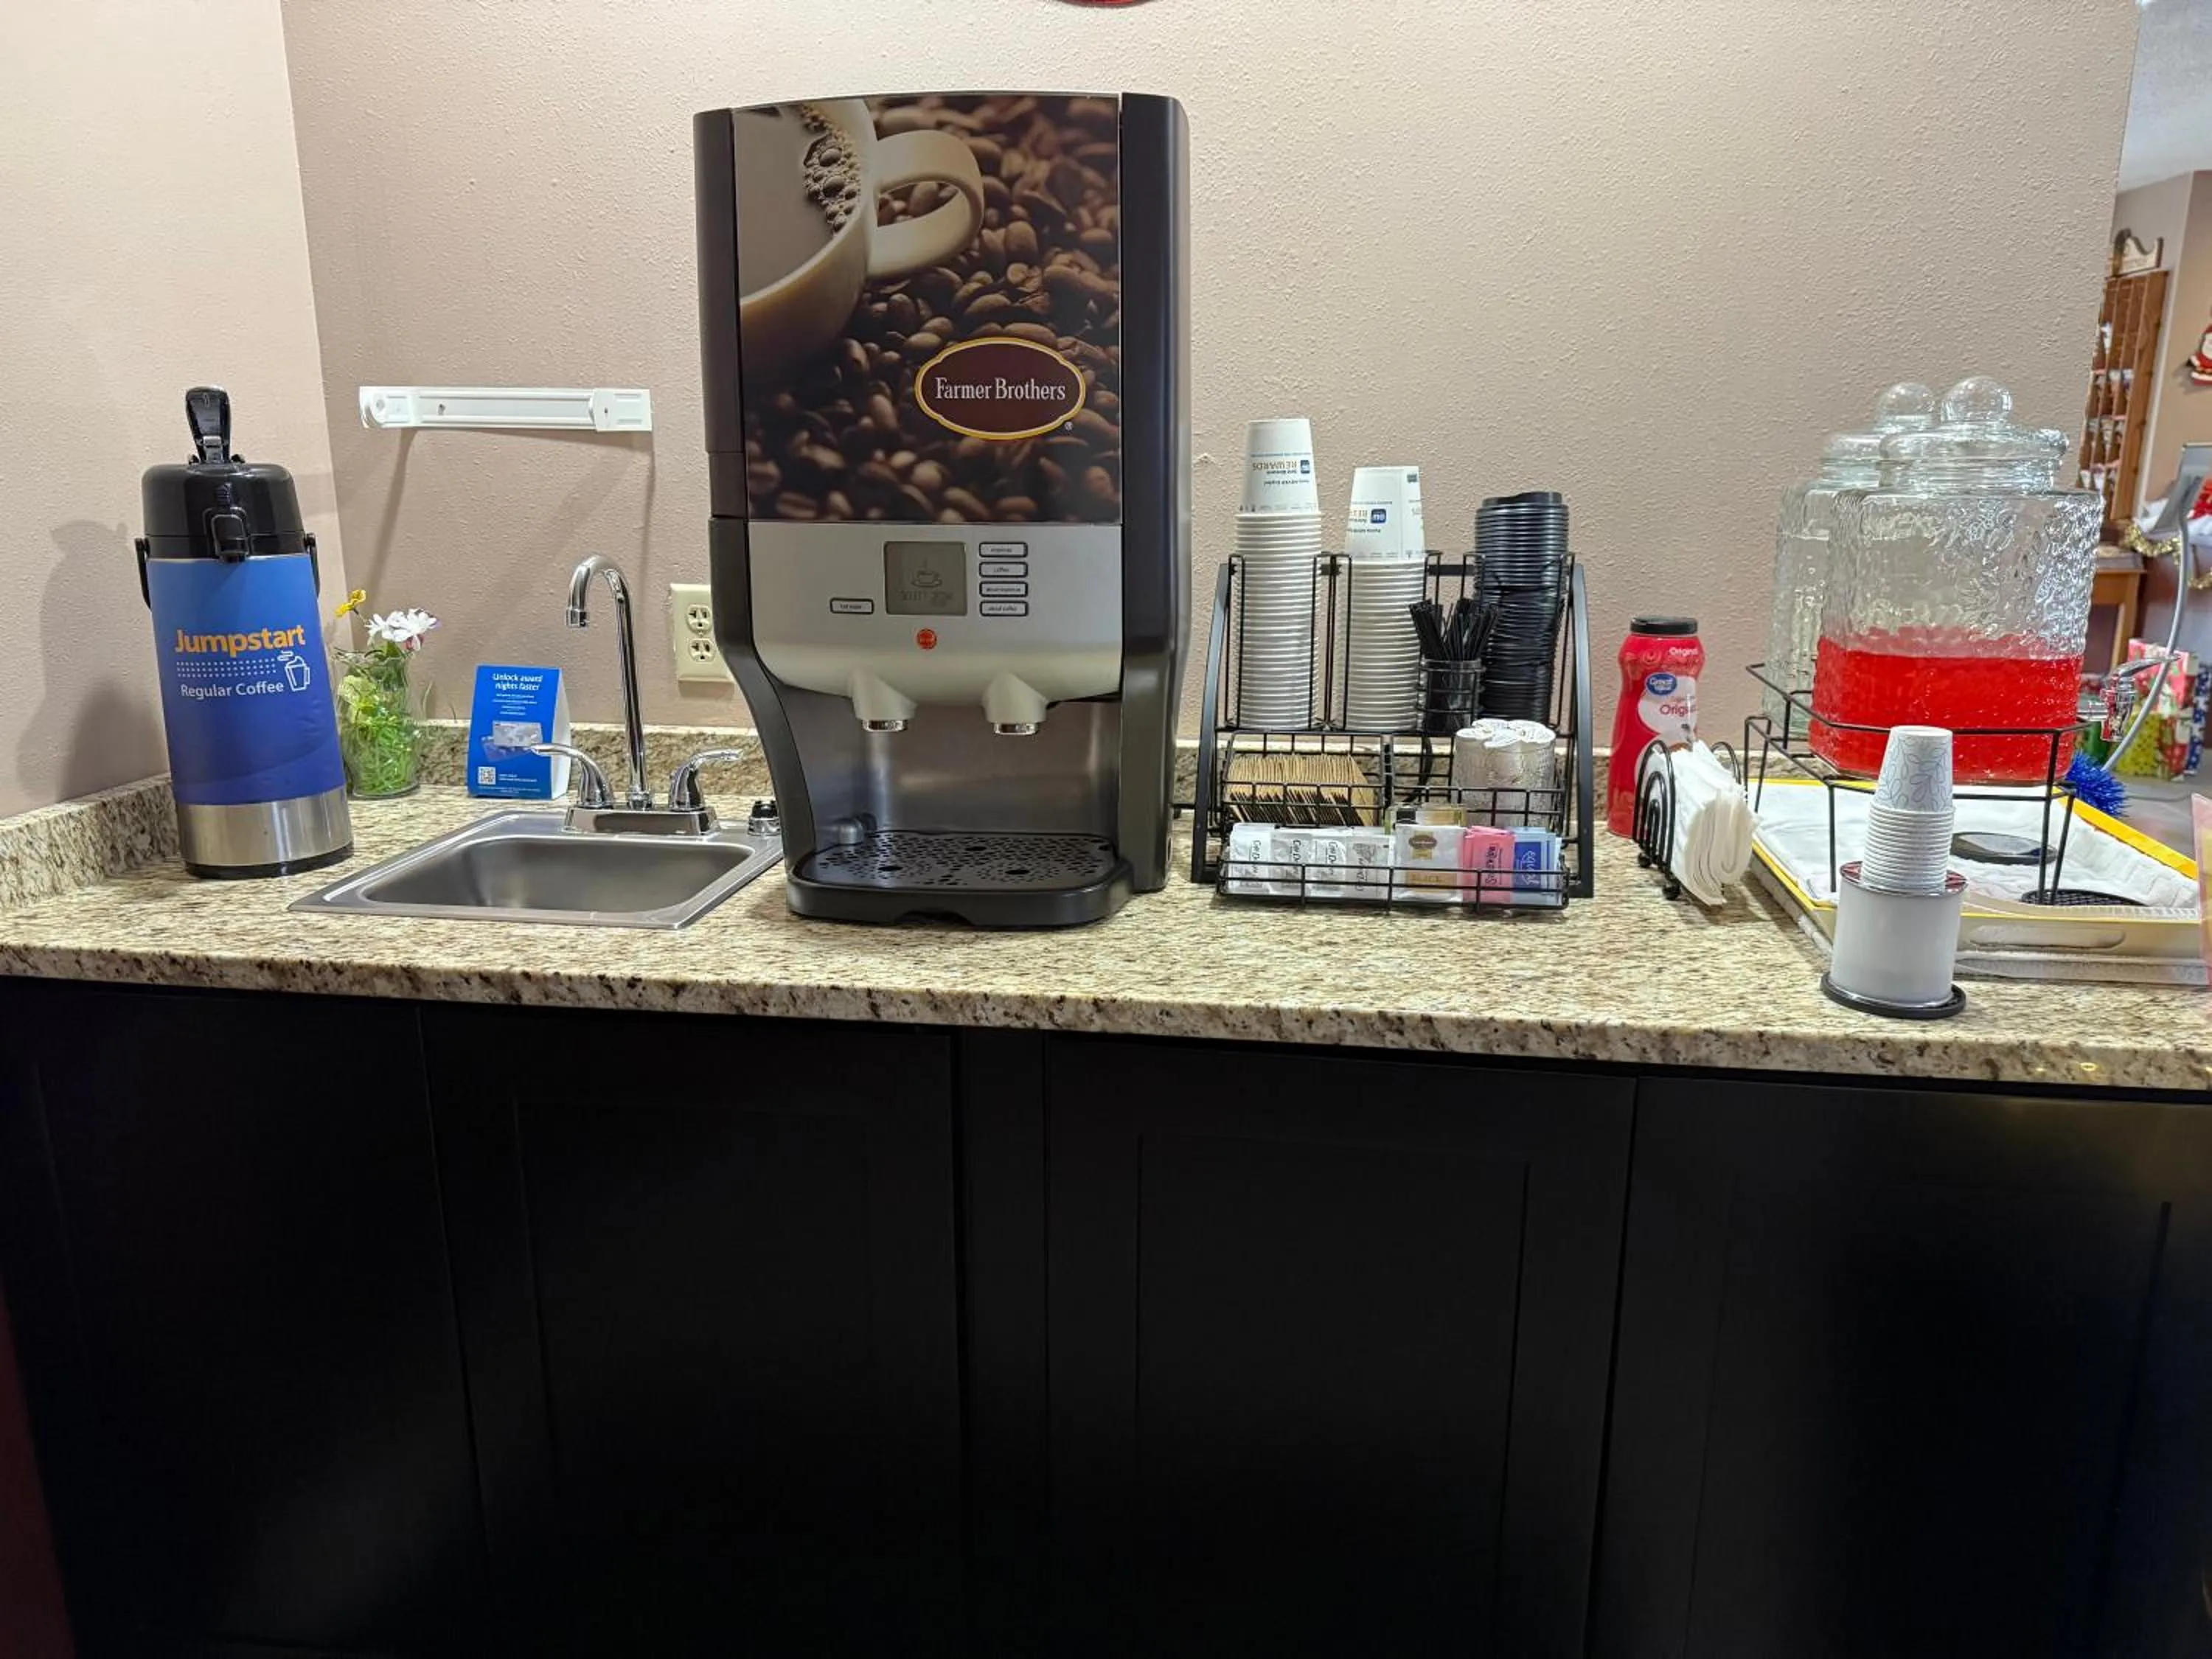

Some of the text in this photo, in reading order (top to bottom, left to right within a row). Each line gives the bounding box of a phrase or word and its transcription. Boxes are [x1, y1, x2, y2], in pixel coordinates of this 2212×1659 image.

[935, 377, 1066, 400] Farmer Brothers
[175, 625, 306, 658] Jumpstart
[181, 681, 284, 700] Regular Coffee
